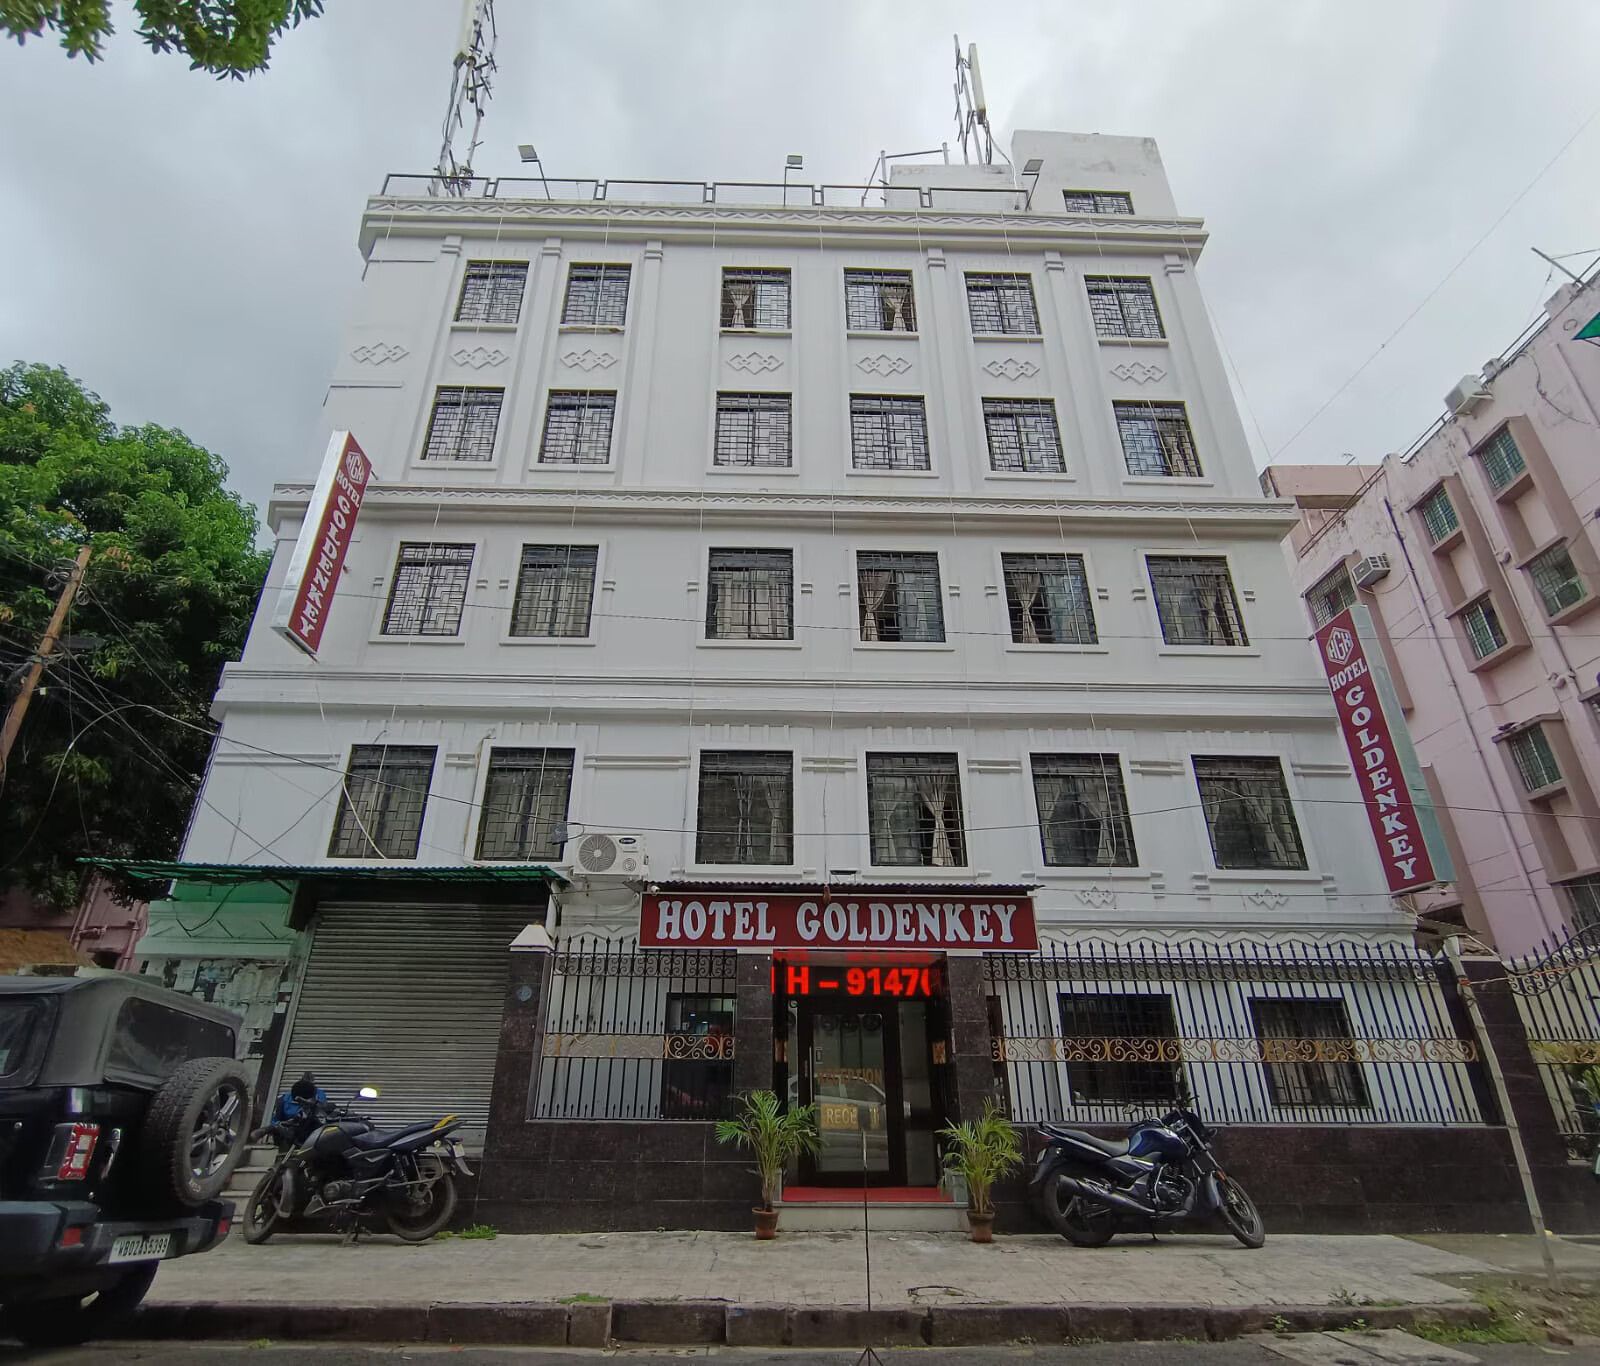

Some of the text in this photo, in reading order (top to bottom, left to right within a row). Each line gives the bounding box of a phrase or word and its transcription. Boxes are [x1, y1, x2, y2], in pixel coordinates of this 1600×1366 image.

[337, 469, 359, 508] HOTEL
[300, 494, 351, 638] GOLDENKEY
[1328, 630, 1352, 661] HGK
[1331, 659, 1367, 691] HOTEL
[1345, 685, 1416, 880] GOLDENKEY
[655, 900, 1017, 943] HOTEL GOLDENKEY
